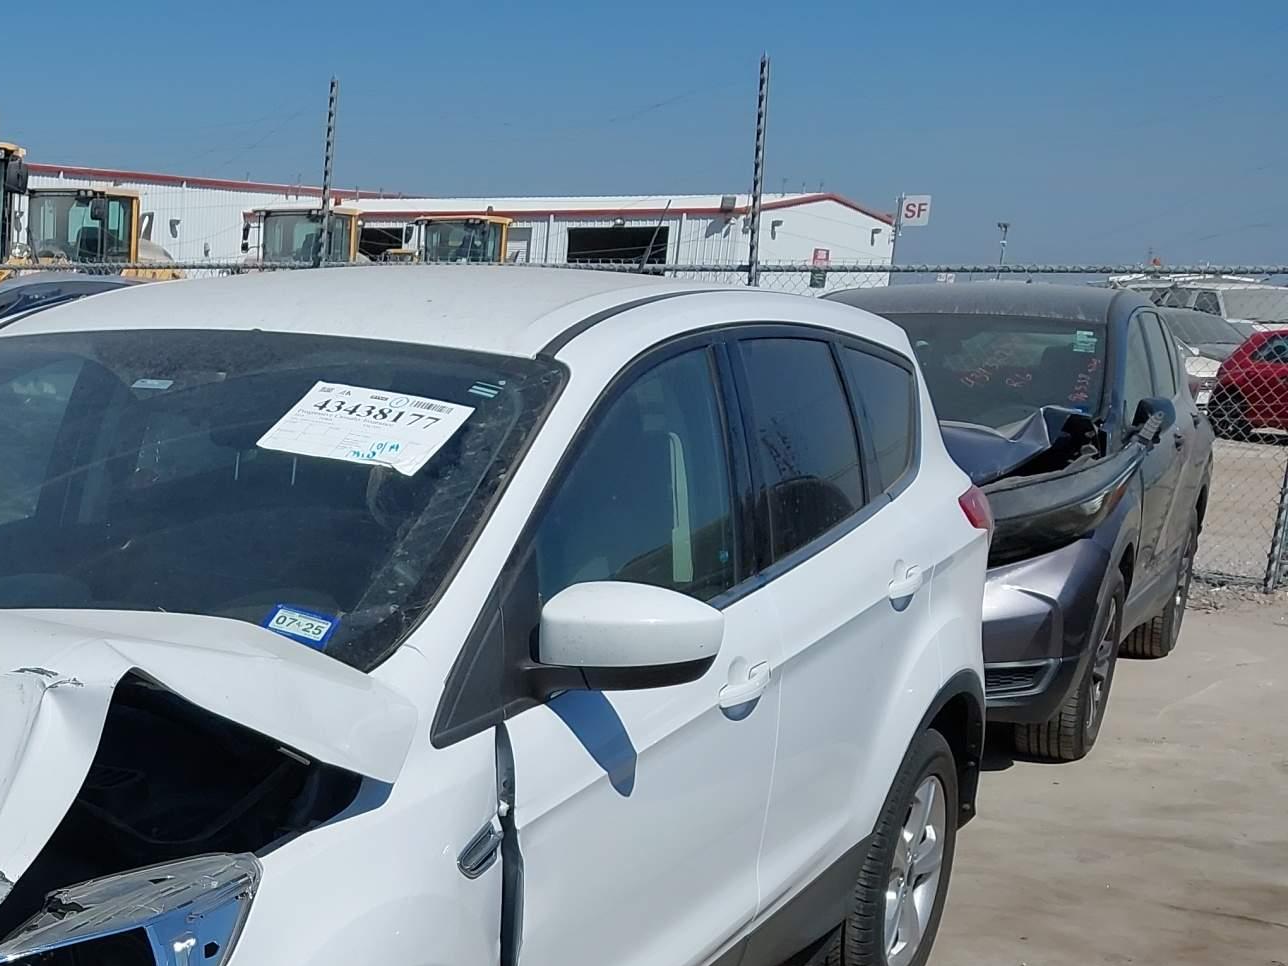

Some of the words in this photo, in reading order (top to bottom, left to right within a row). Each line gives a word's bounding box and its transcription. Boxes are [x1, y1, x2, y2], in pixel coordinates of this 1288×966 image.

[904, 202, 928, 219] SF
[313, 399, 440, 429] 43438177
[275, 615, 298, 628] 07
[301, 622, 325, 636] 25
